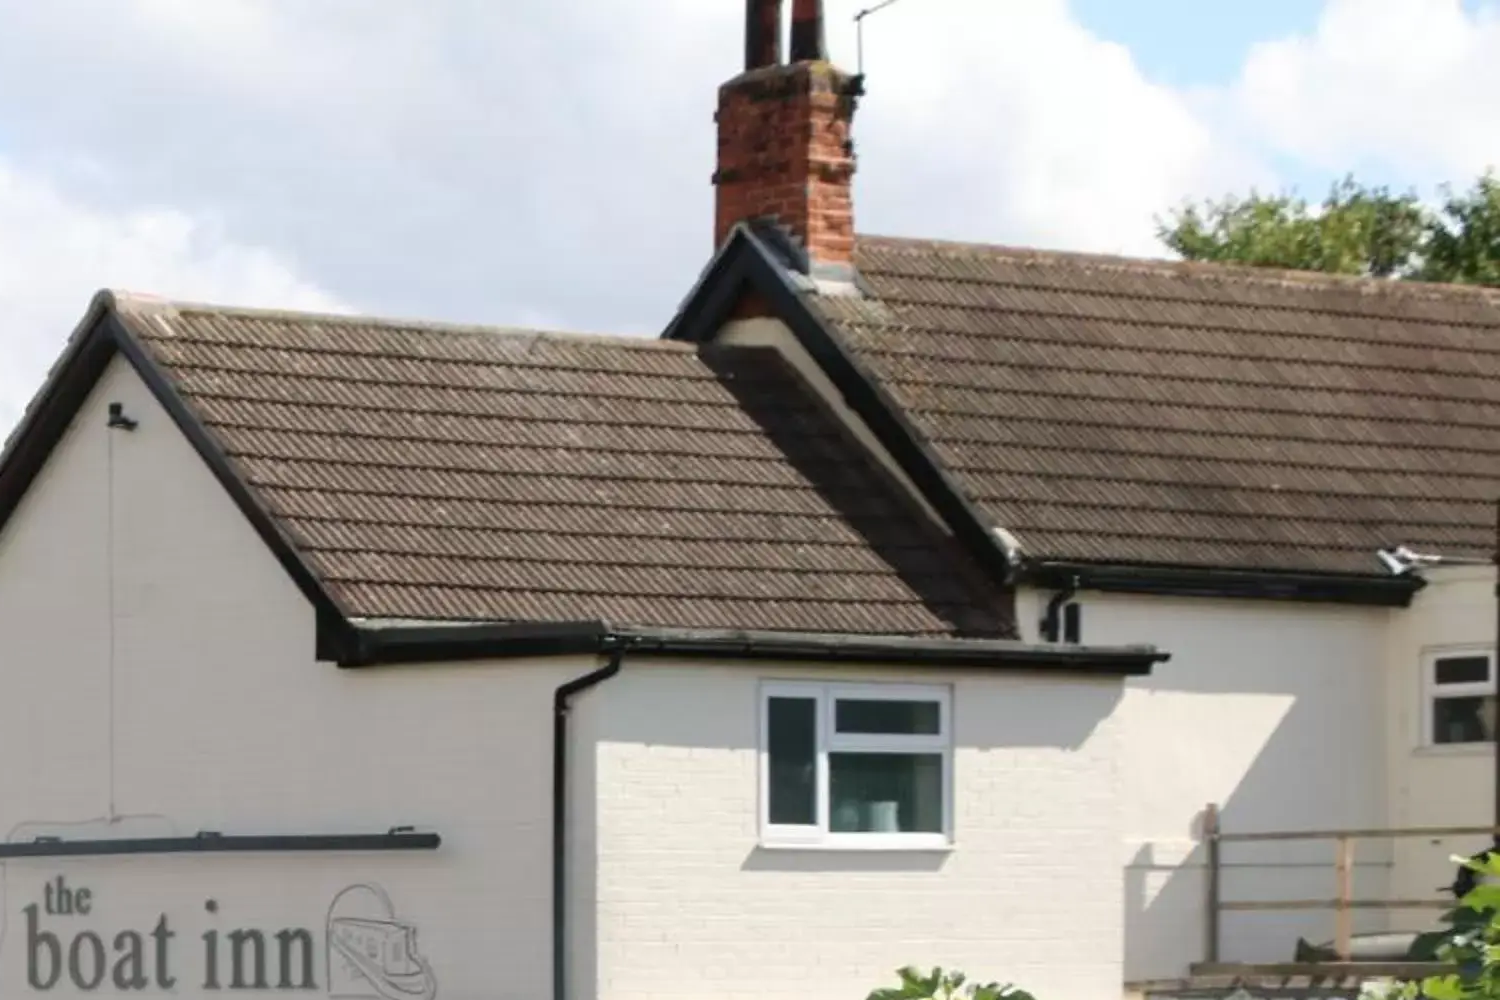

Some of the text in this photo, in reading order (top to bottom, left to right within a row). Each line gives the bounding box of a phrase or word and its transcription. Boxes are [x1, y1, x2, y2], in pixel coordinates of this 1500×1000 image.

[44, 875, 92, 915] the
[21, 898, 319, 991] boat inn
